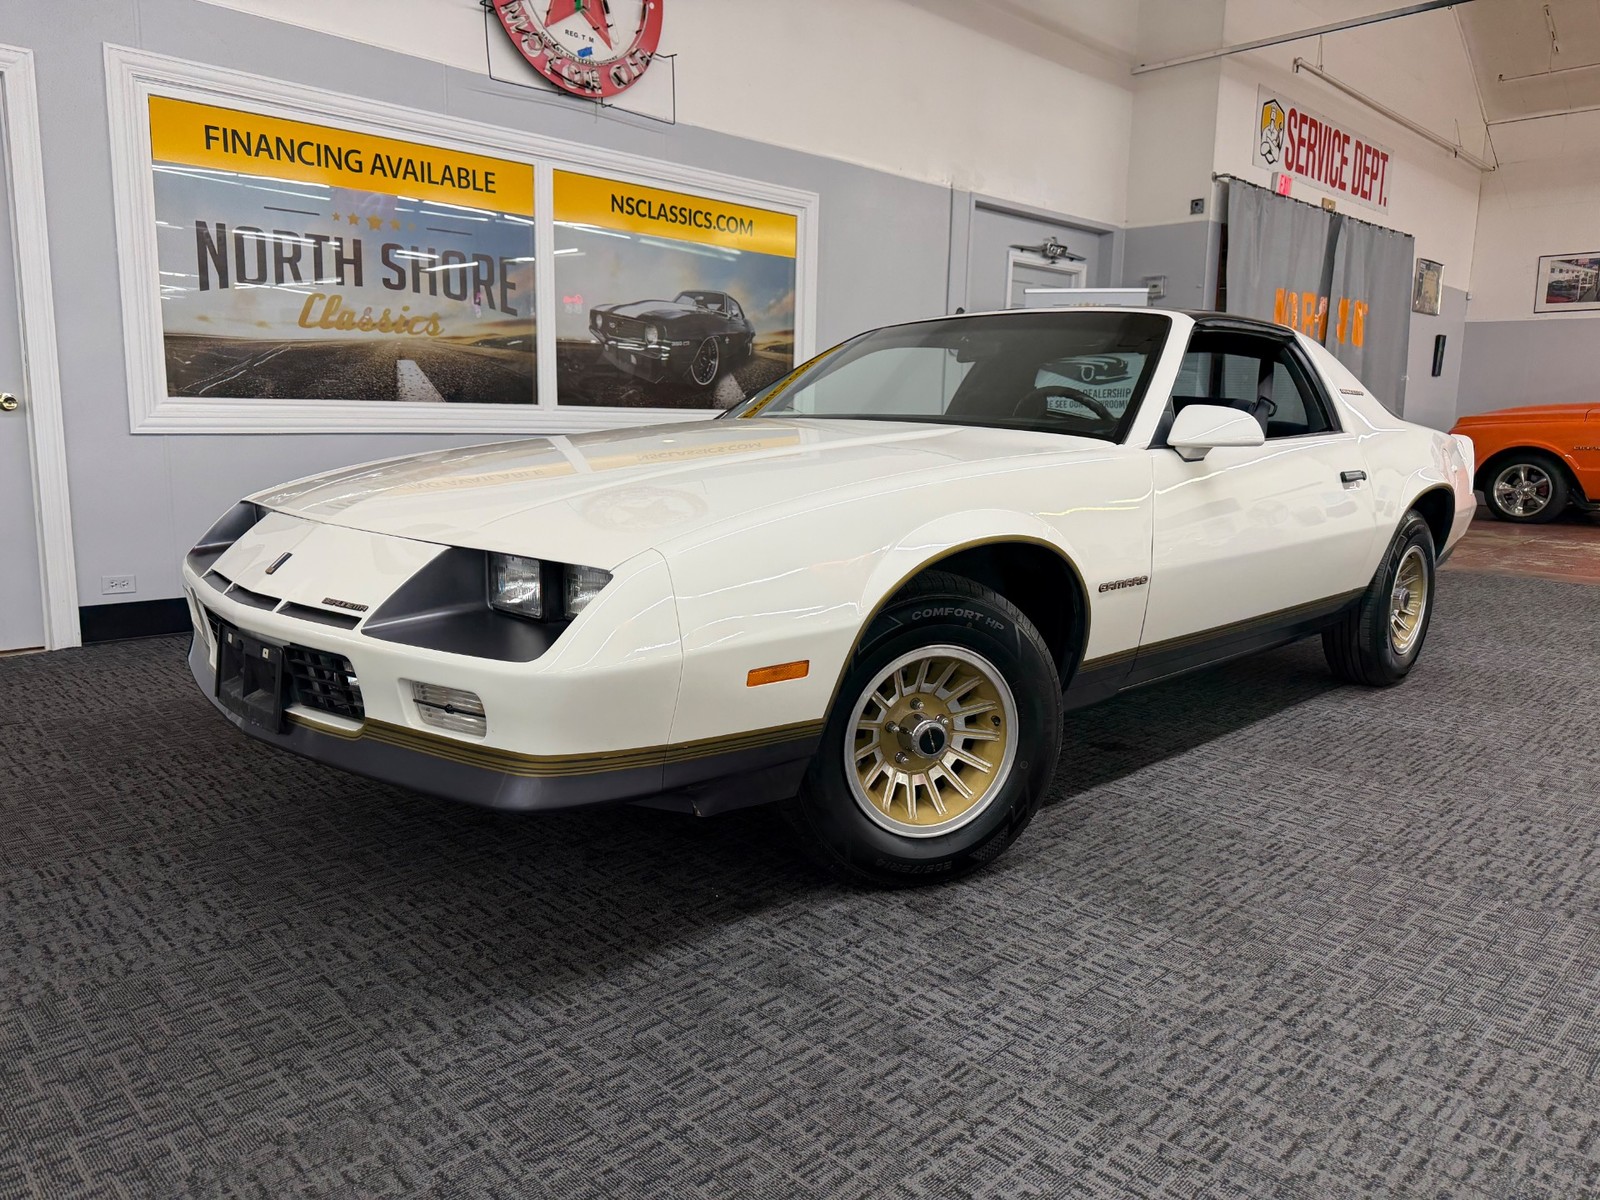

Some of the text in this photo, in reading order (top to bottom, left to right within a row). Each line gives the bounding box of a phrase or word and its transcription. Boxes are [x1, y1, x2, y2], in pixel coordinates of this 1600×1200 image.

[204, 125, 497, 194] FINANCING AVAILABLE
[1285, 108, 1388, 207] SERVICE DEPT.
[611, 194, 753, 236] NSCLASSICS.COM
[195, 220, 518, 316] NORTH SHORE
[298, 293, 445, 337] Classics
[1055, 400, 1068, 408] SEE
[912, 607, 1005, 630] COMFORT HP
